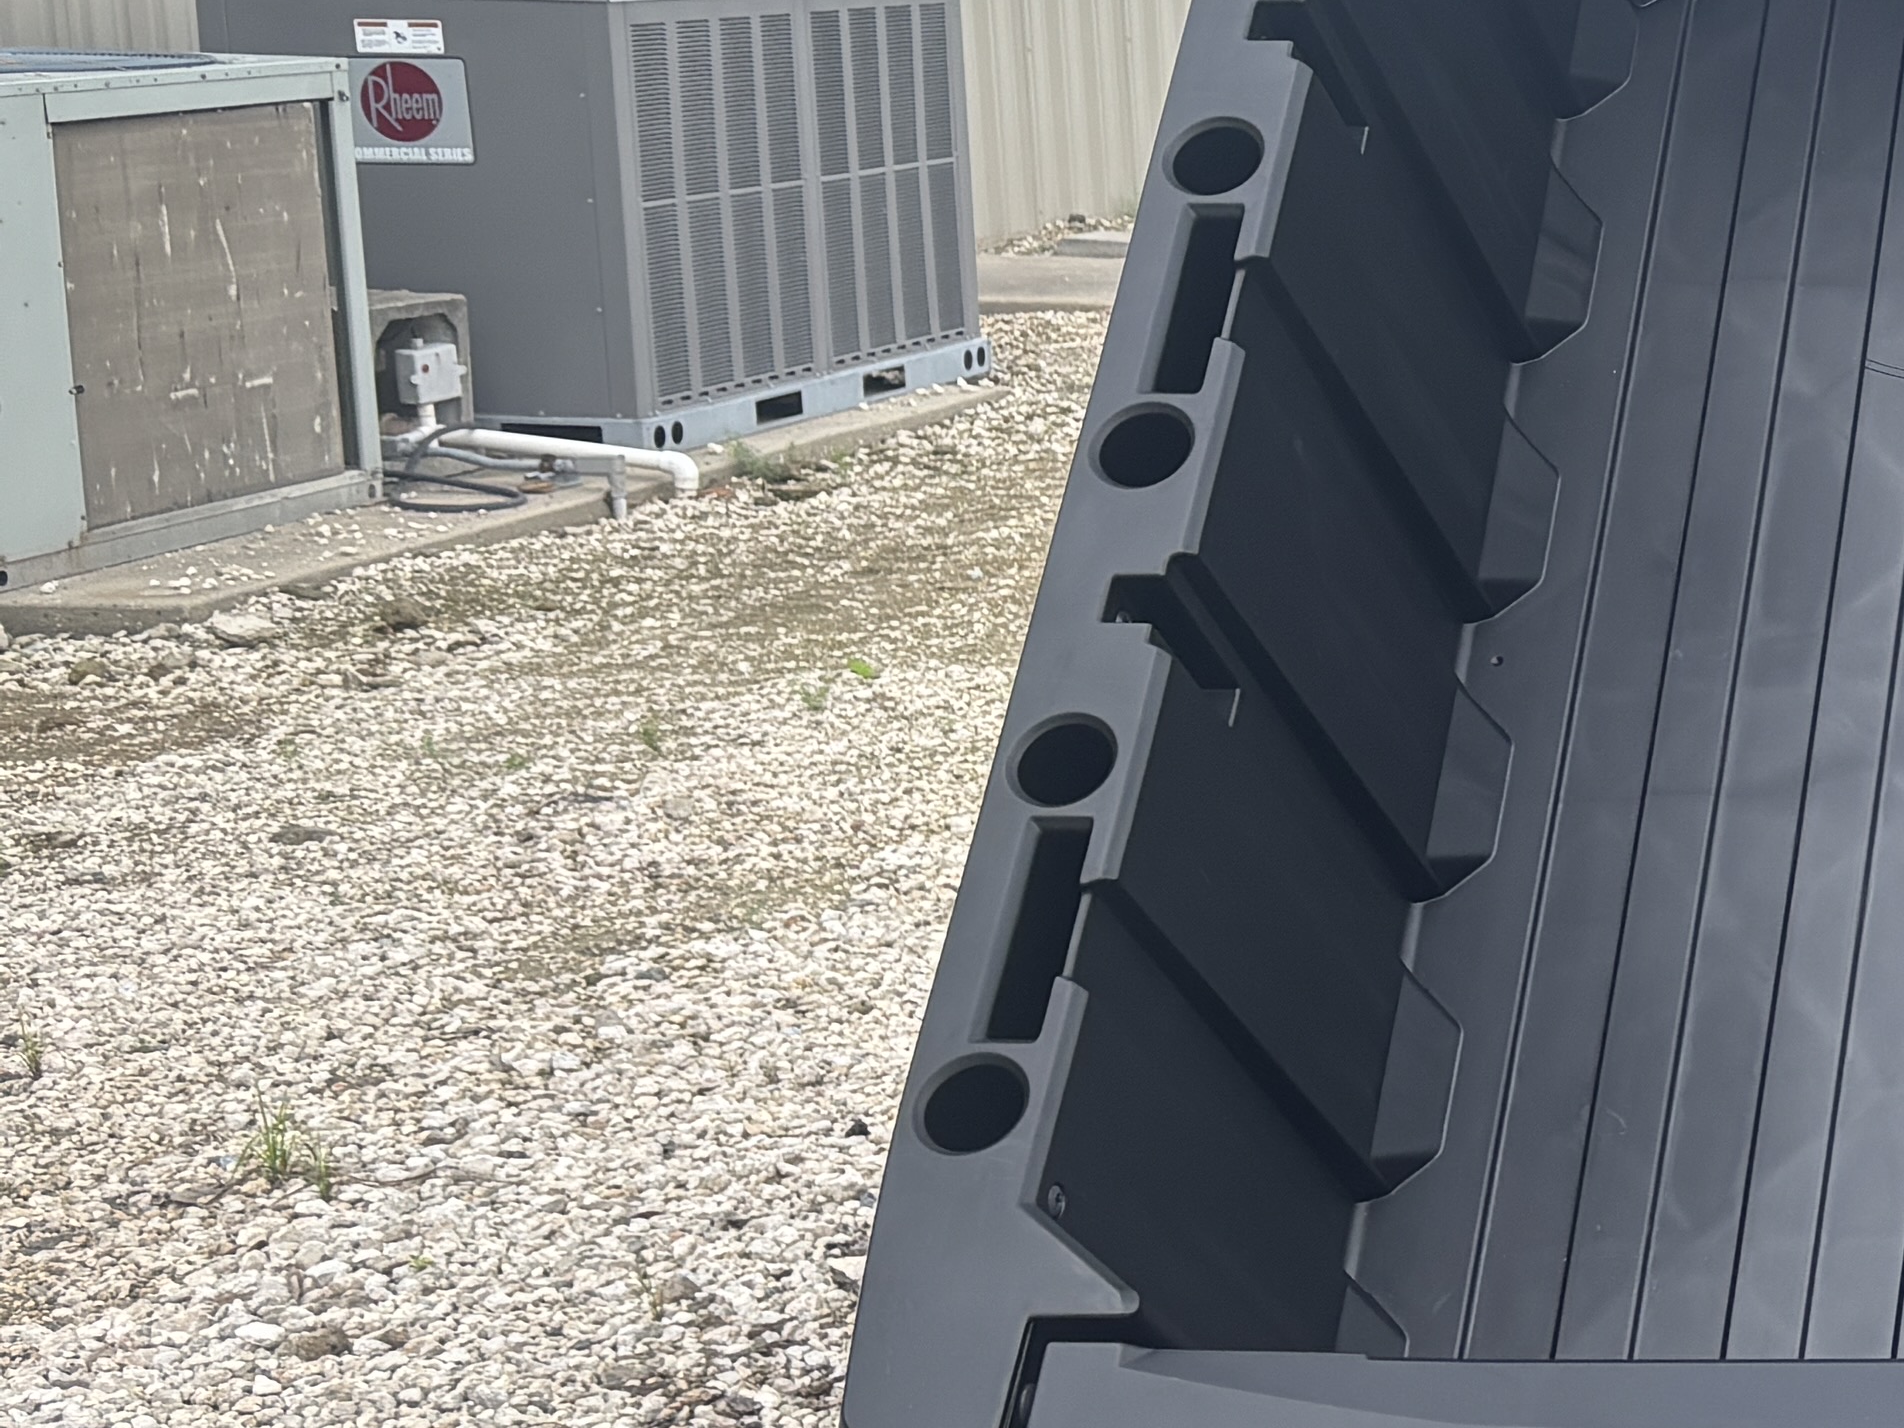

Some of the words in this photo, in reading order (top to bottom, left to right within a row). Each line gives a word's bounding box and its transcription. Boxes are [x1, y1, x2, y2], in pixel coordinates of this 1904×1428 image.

[366, 62, 440, 132] Rheem
[354, 146, 426, 160] OMMERCIAL
[427, 147, 474, 161] SERIES
